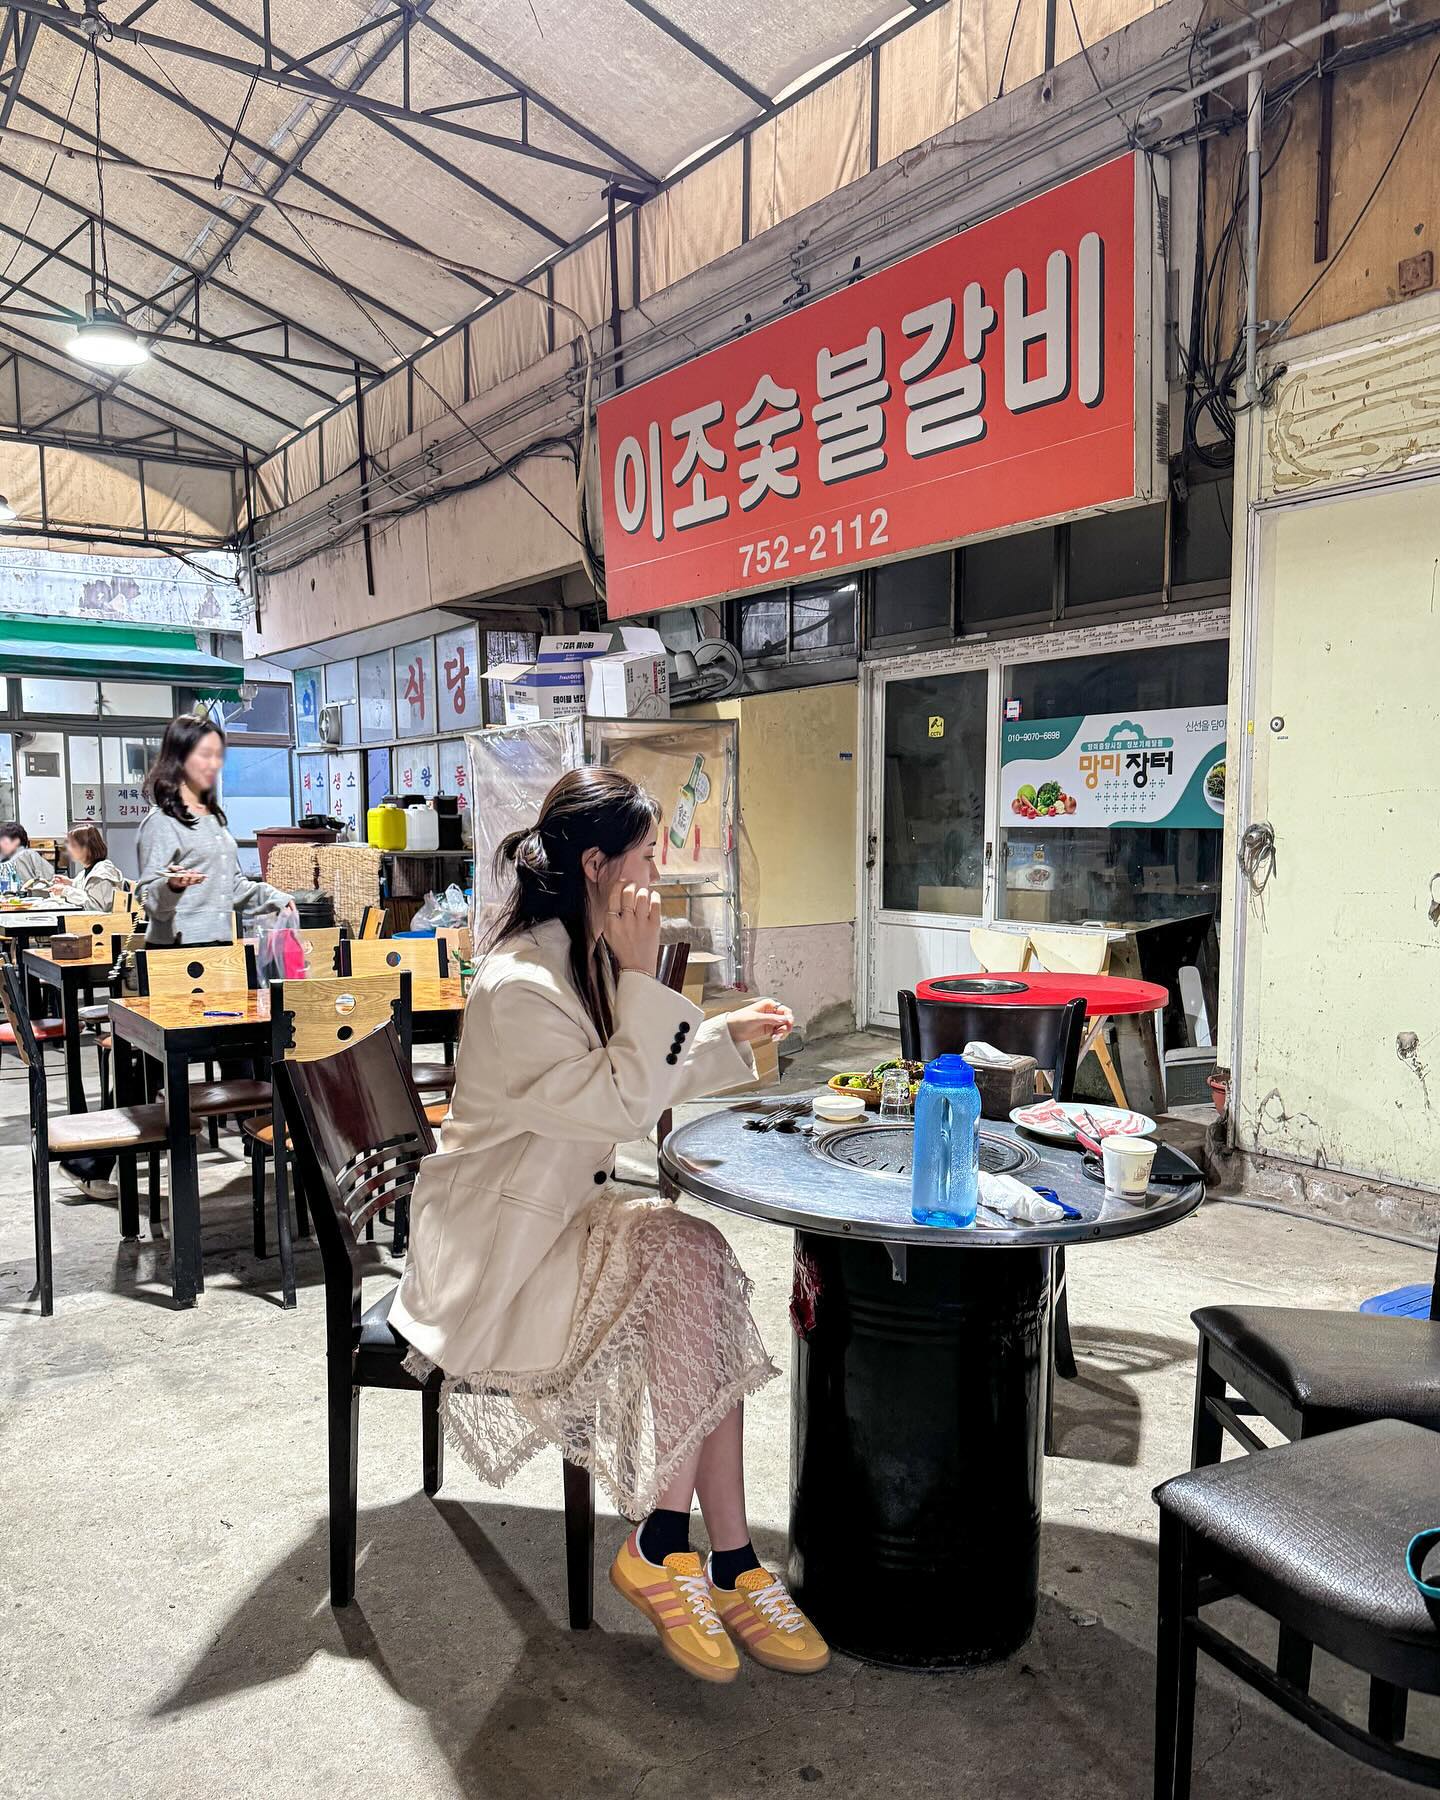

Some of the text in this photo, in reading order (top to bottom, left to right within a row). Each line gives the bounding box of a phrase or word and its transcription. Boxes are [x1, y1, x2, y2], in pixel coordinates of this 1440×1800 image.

[613, 231, 1105, 541] 이조숯불갈비
[738, 508, 889, 578] 752-2112
[553, 695, 572, 704] 테이블
[1185, 719, 1210, 733] 신선을
[1079, 751, 1174, 790] 망미 장터
